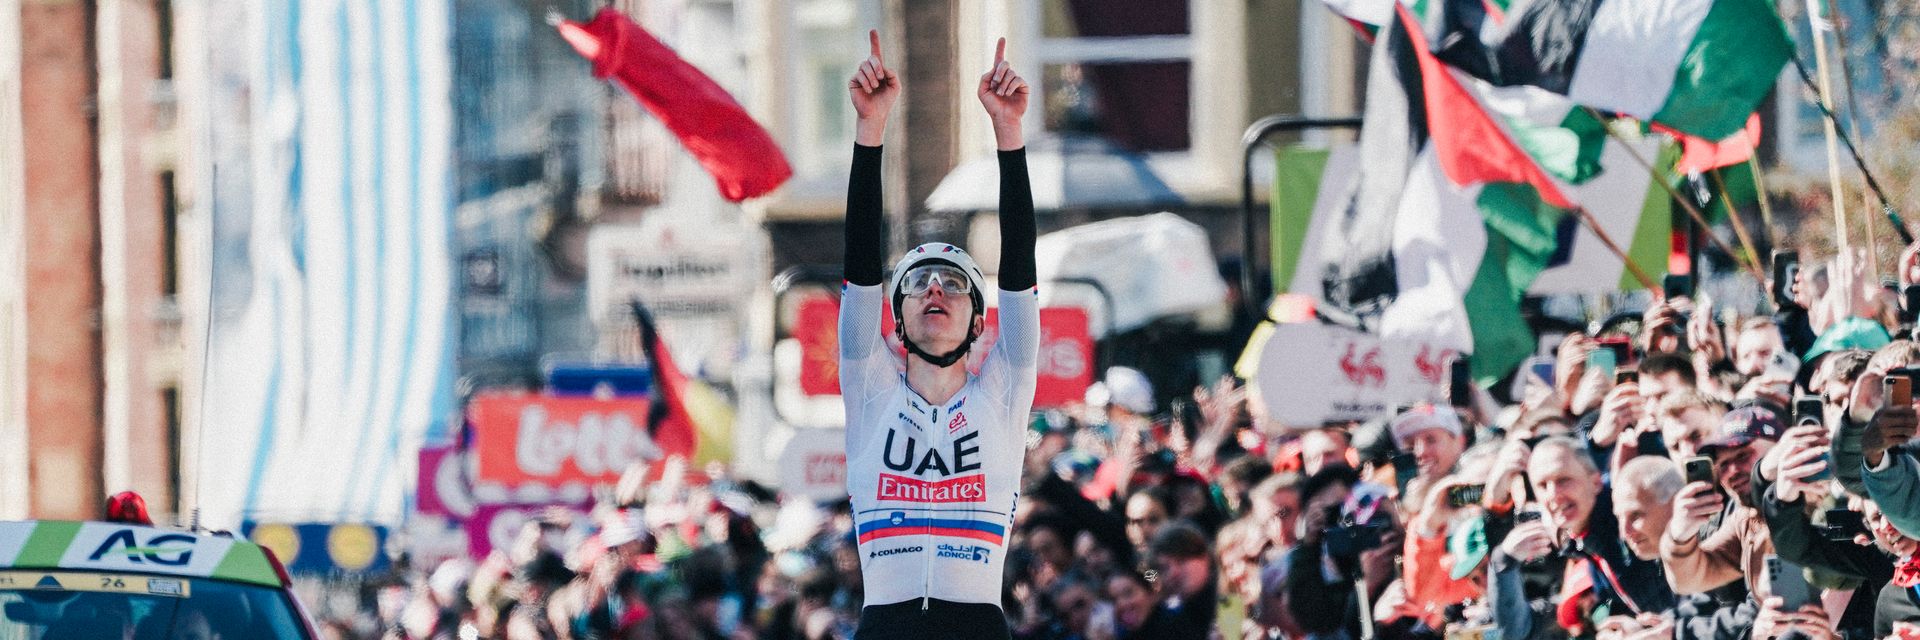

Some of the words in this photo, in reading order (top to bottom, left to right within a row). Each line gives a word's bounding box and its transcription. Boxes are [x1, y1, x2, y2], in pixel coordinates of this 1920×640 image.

[883, 428, 982, 477] UAE
[881, 476, 982, 500] Emirates
[88, 529, 197, 566] AG
[877, 546, 923, 557] COLNAGO
[937, 550, 972, 560] ADNOC
[101, 577, 125, 589] 26
